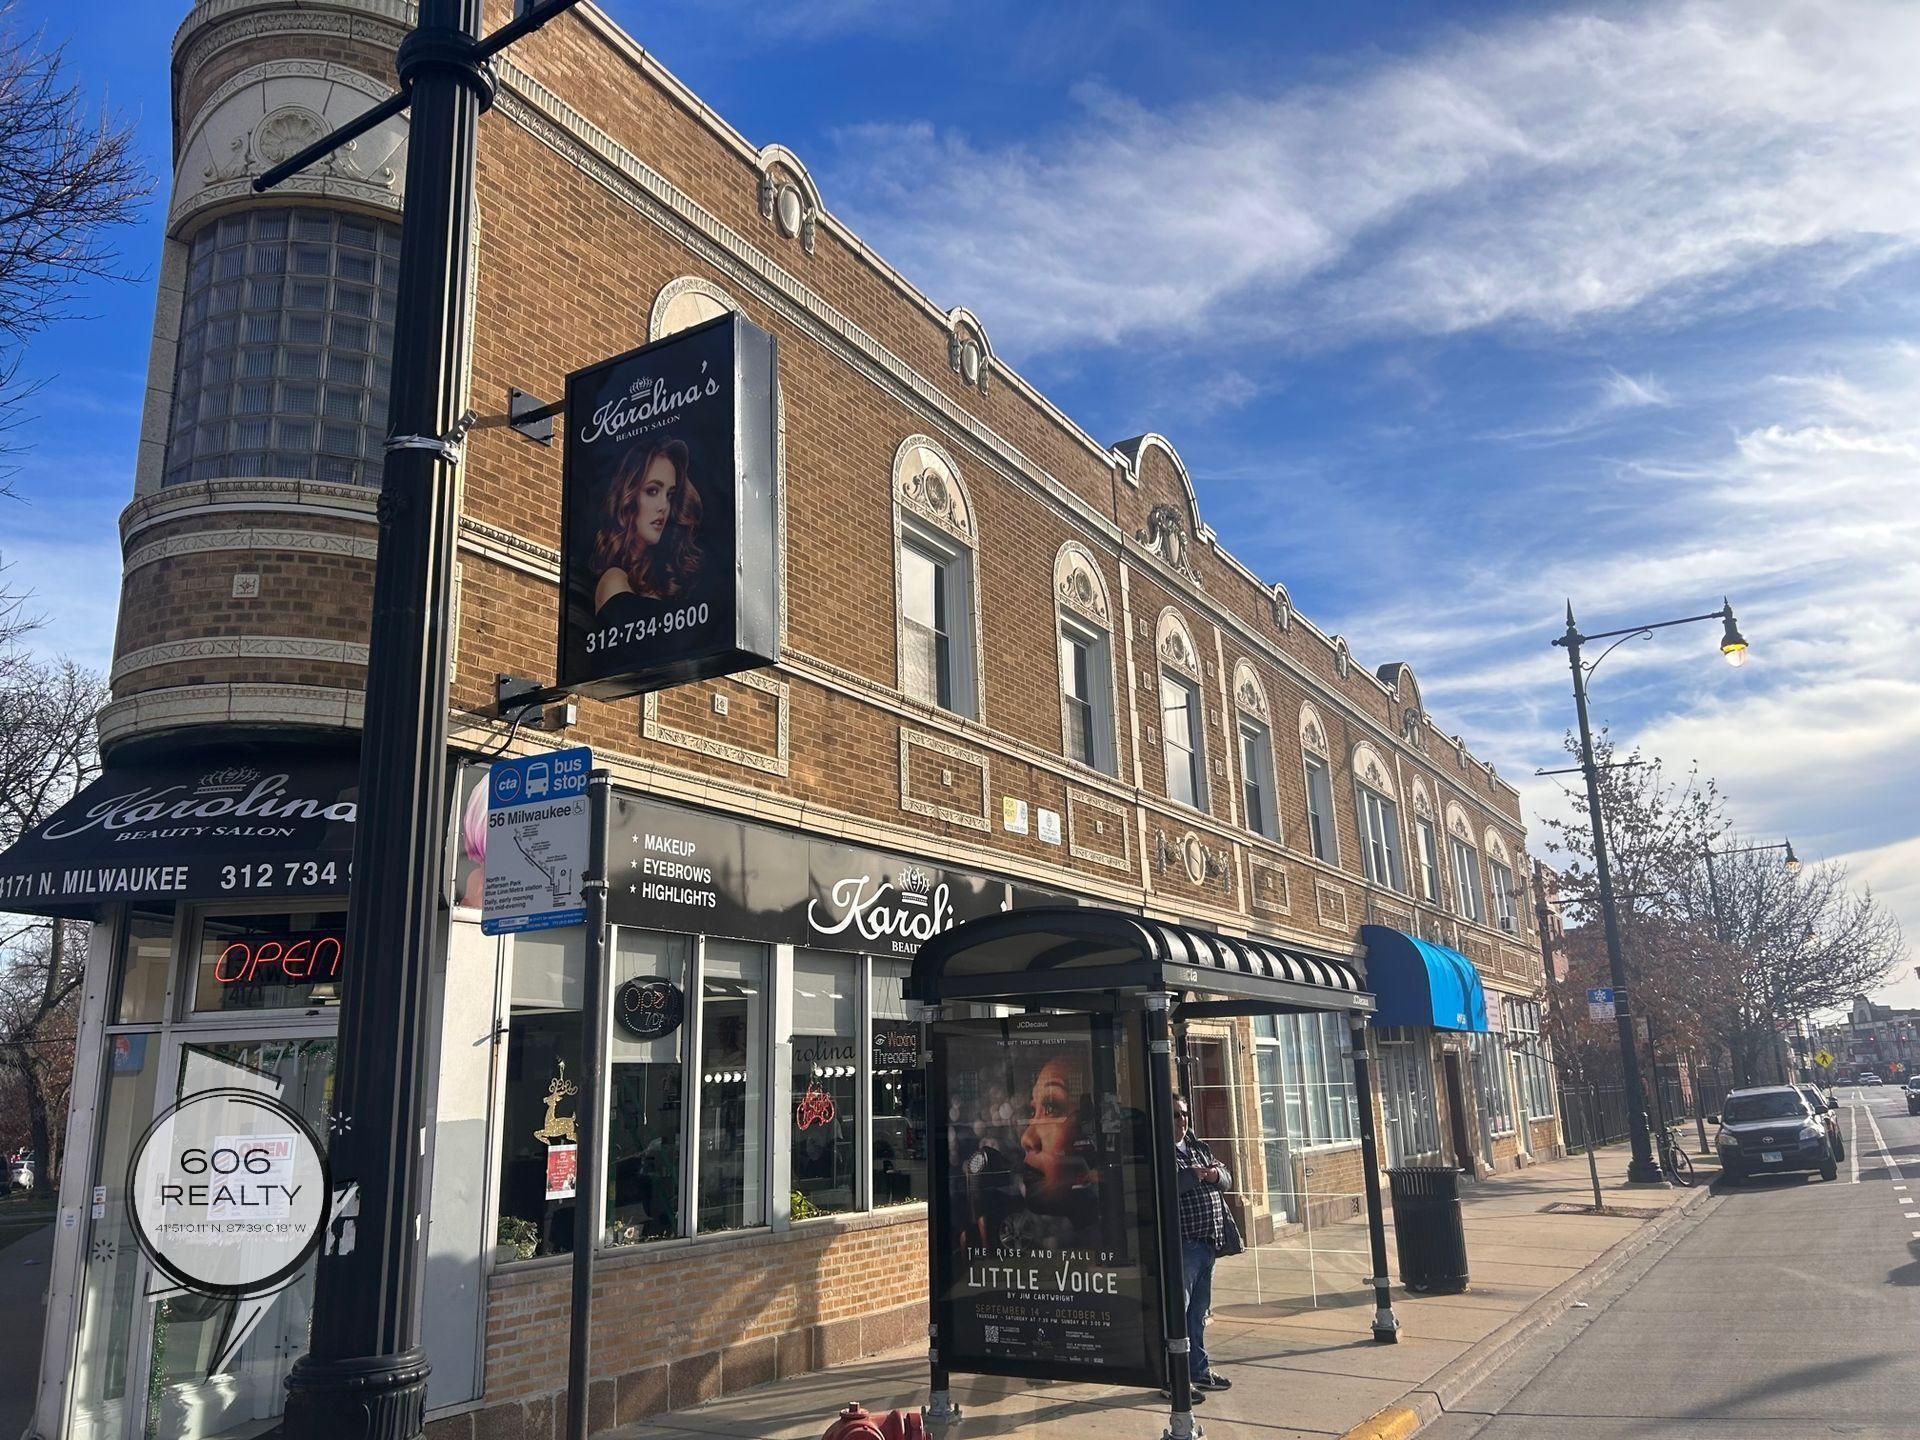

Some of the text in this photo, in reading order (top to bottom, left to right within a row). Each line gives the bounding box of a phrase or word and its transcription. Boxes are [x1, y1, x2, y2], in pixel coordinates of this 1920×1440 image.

[580, 360, 720, 443] Karolina's
[615, 414, 681, 442] BEAUTY SALON
[554, 758, 582, 774] bus
[498, 777, 517, 791] cta
[553, 774, 587, 791] stop
[42, 774, 357, 840] Karolina
[489, 805, 571, 828] 56 Milwaukee
[114, 826, 296, 842] BEAUTY SALON
[644, 833, 696, 857] MAKEUP
[38, 872, 56, 895] N.
[62, 866, 189, 894] MILWAUKEE
[220, 863, 273, 889] 312
[284, 861, 337, 886] 734
[643, 859, 711, 884] EYEBROWS
[642, 883, 716, 908] HIGHLIGHTS
[808, 875, 965, 941] Karoli
[215, 937, 341, 982] OPEN
[1017, 1021, 1048, 1029] JCDecaux
[968, 1247, 1114, 1262] THE RISE AND FALL OF
[968, 1260, 1118, 1294] LITTLE VOICE
[1034, 1293, 1074, 1302] CARTWRIGHT
[975, 1304, 1026, 1315] SEPTEMBER
[1031, 1307, 1039, 1316] 14
[1055, 1308, 1096, 1320] OCTOBER
[1101, 1311, 1111, 1321] 15
